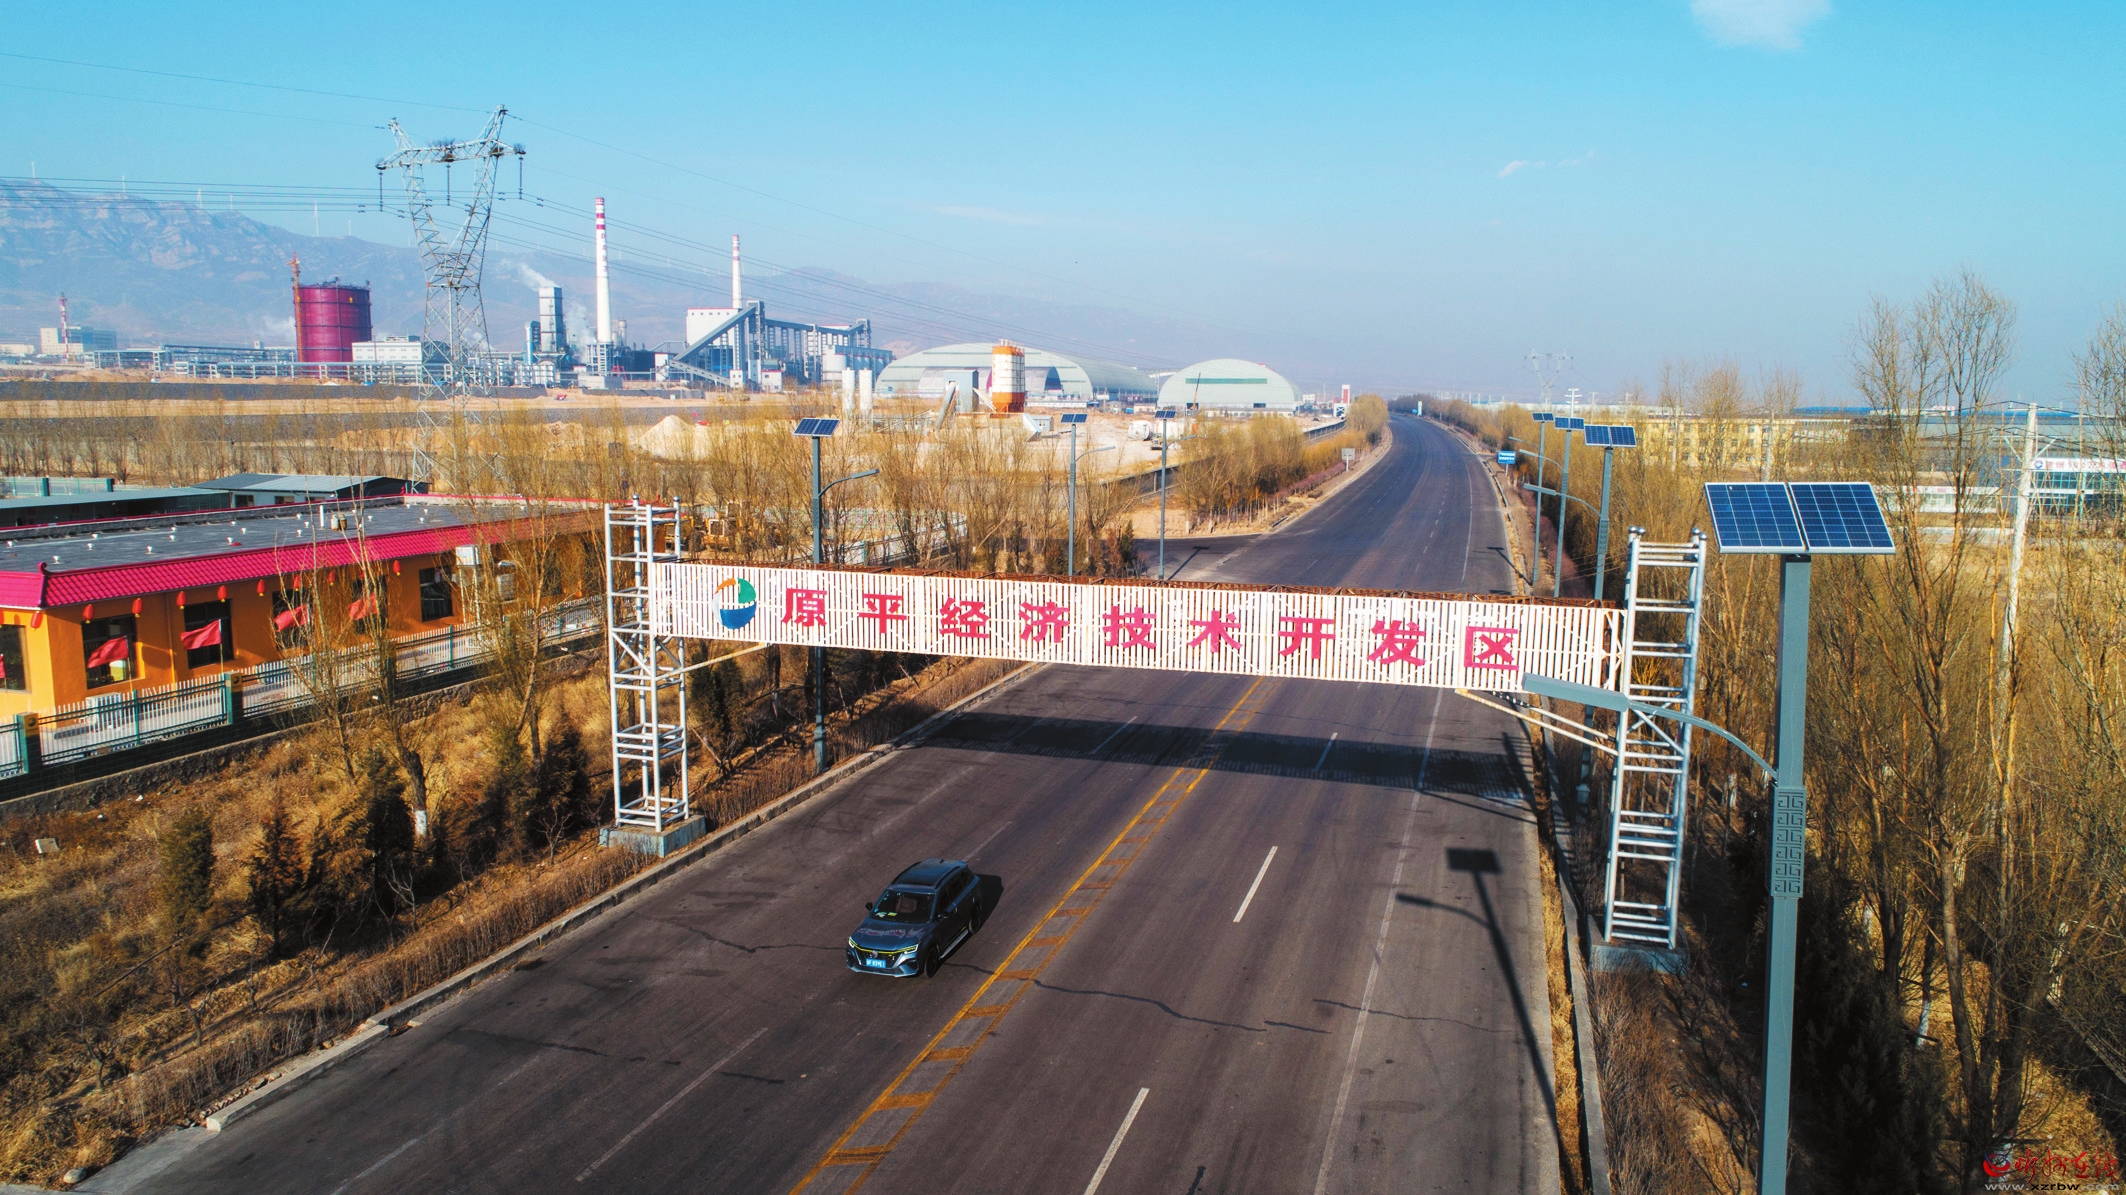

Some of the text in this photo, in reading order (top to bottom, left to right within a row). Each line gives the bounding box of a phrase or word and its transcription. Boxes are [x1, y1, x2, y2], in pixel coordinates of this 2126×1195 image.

[782, 588, 1520, 670] 原平经济技术开发区
